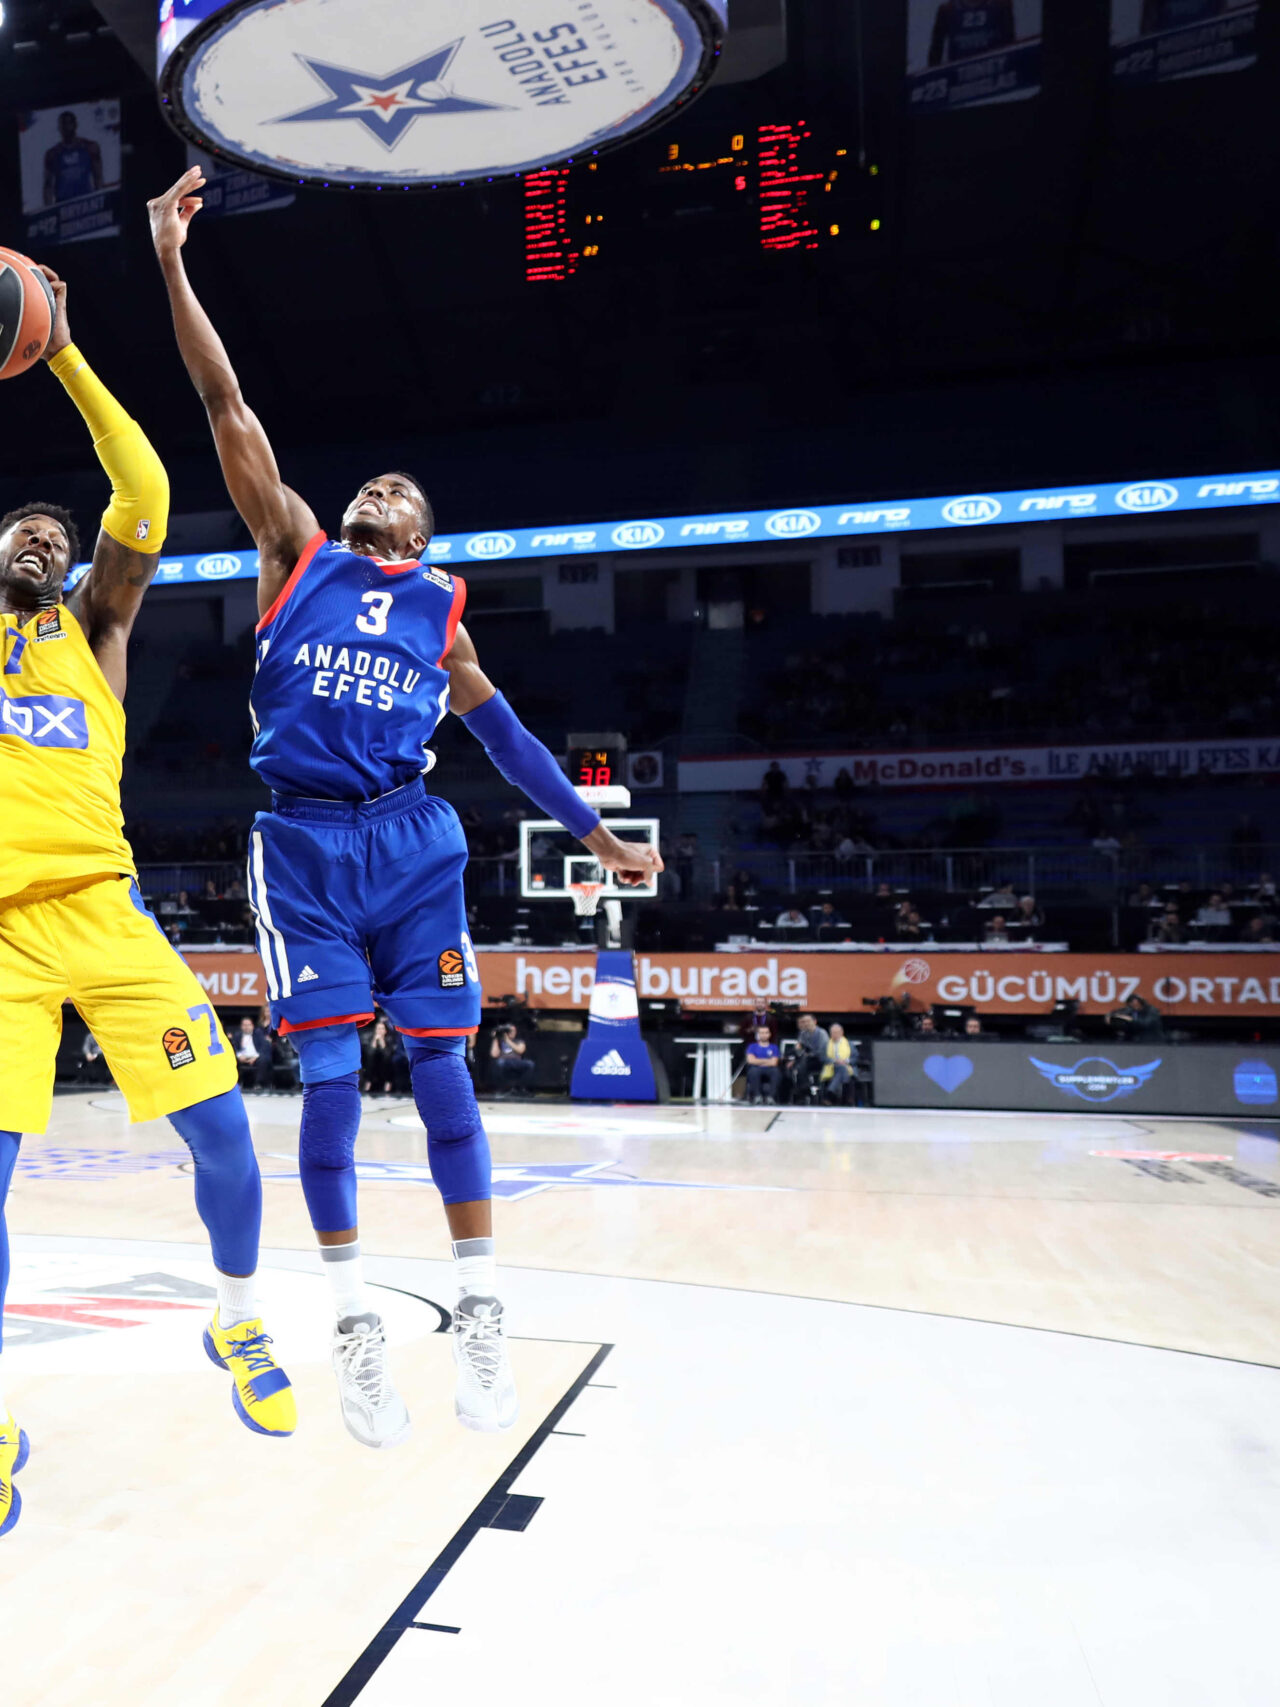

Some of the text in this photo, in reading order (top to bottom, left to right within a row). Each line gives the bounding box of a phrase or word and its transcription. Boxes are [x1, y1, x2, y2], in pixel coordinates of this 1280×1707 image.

[479, 19, 572, 107] ANADOLU
[532, 22, 608, 87] EFES
[474, 536, 508, 551] KIA
[622, 526, 655, 543] KIA
[773, 515, 813, 532] KIA
[951, 501, 993, 519] KIA
[1125, 488, 1168, 506] KIA
[355, 590, 394, 636] 3
[4, 627, 28, 674] 7
[293, 643, 421, 694] ANADOLU
[312, 670, 394, 711] EFES
[853, 755, 1027, 780] McDonald's
[461, 931, 479, 983] 3
[937, 970, 1140, 1004] GÜCÜMÜZ
[186, 1003, 225, 1056] 7
[591, 1064, 631, 1075] adidas
